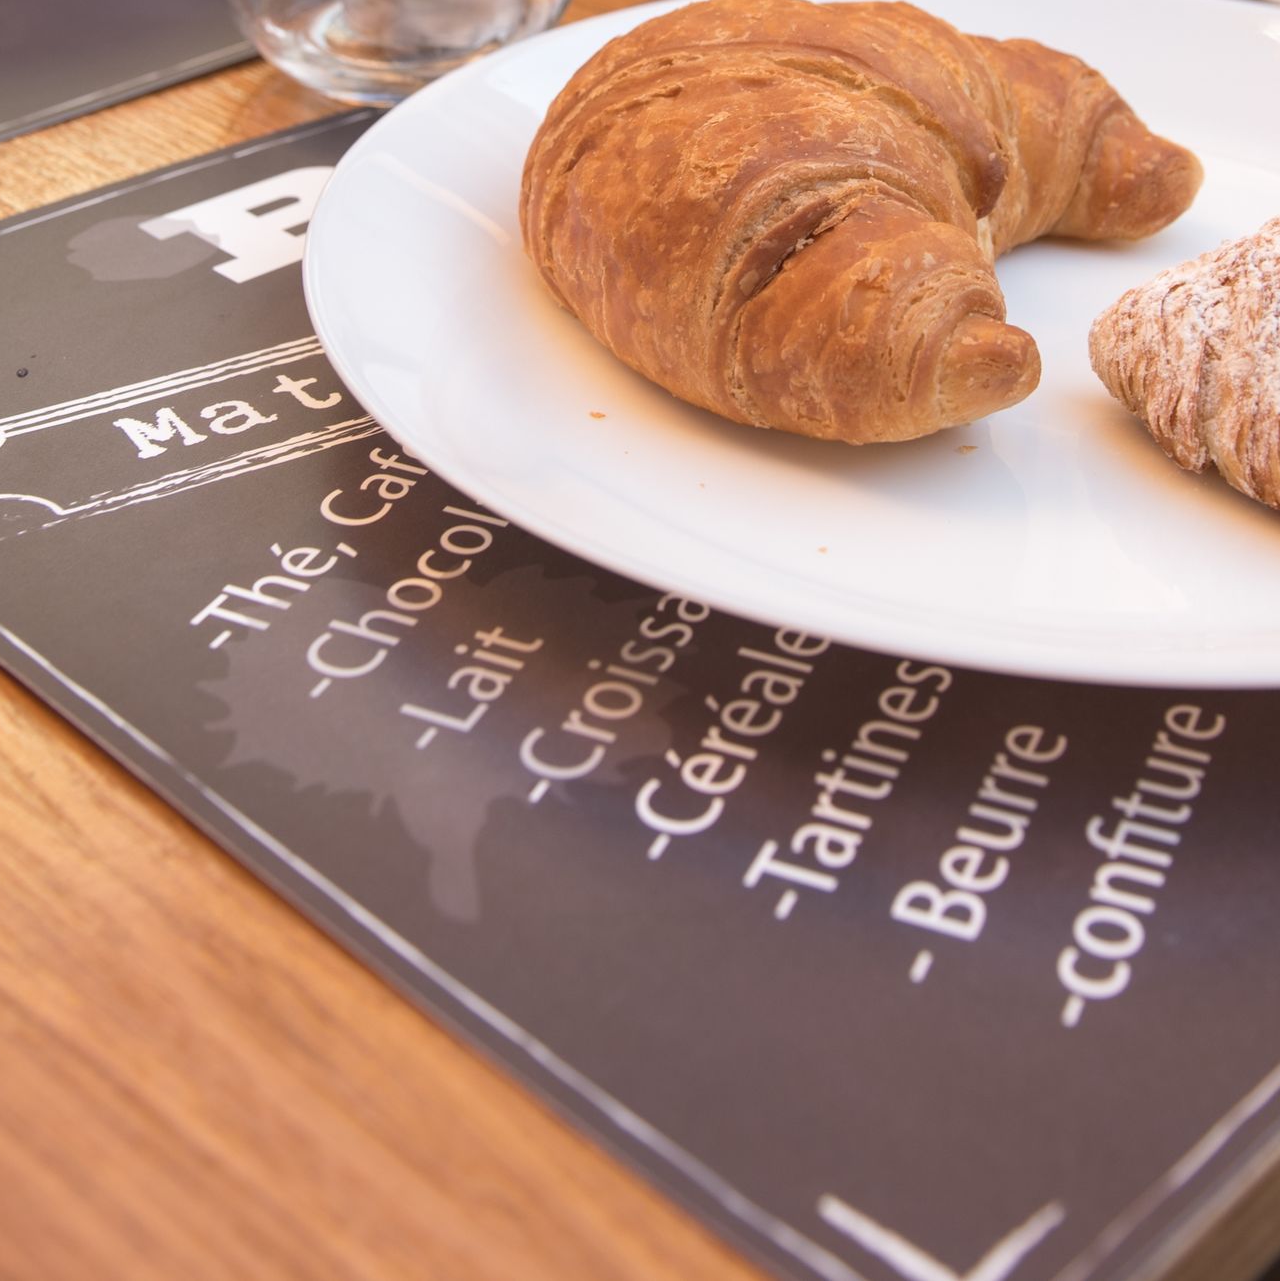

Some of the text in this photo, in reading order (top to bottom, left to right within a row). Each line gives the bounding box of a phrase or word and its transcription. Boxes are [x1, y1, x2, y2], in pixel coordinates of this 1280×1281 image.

[319, 444, 429, 528] Caf
[306, 501, 510, 699] -Chocol
[400, 625, 545, 750] -Lait
[742, 658, 953, 921] -Tartines
[1056, 703, 1226, 1028] -confiture
